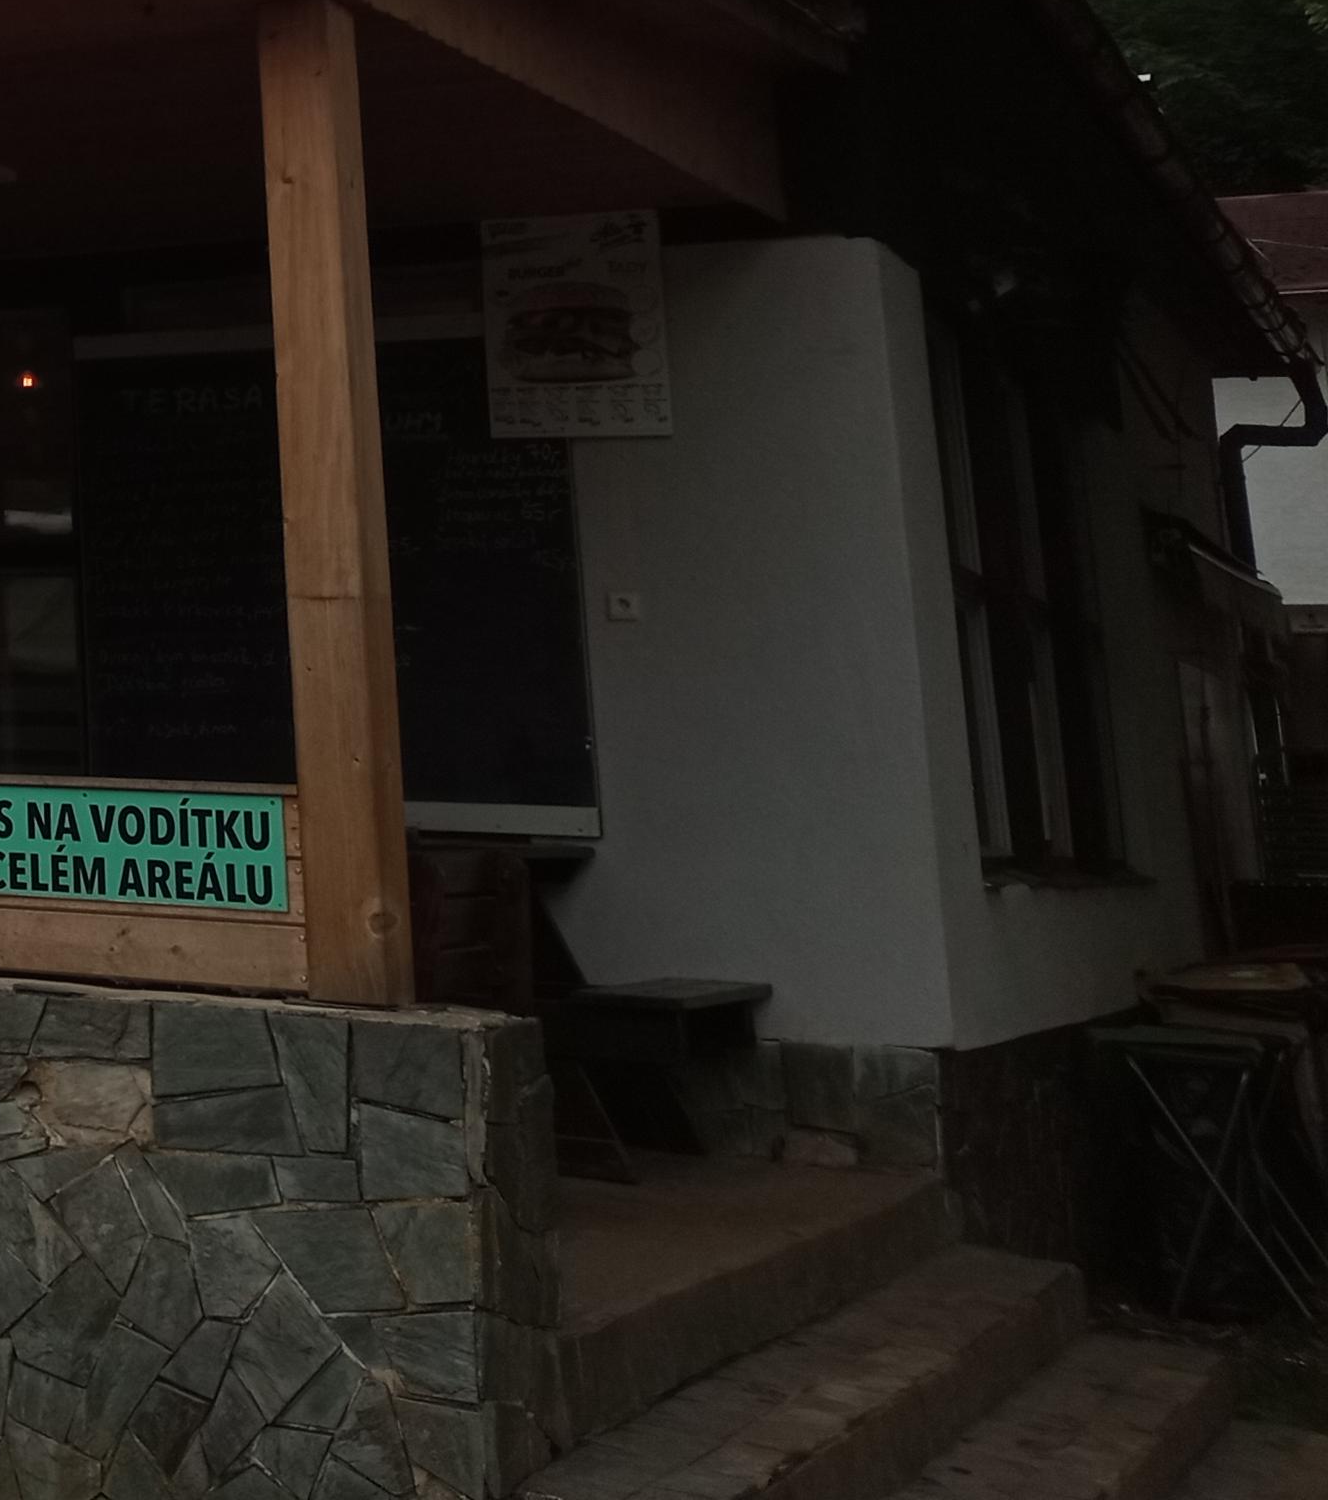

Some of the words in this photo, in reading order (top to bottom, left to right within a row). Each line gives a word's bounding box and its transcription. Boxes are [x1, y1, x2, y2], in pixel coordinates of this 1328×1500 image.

[28, 802, 81, 842] NA
[90, 797, 270, 851] VODÍTKU
[119, 852, 273, 905] AREÁLU
